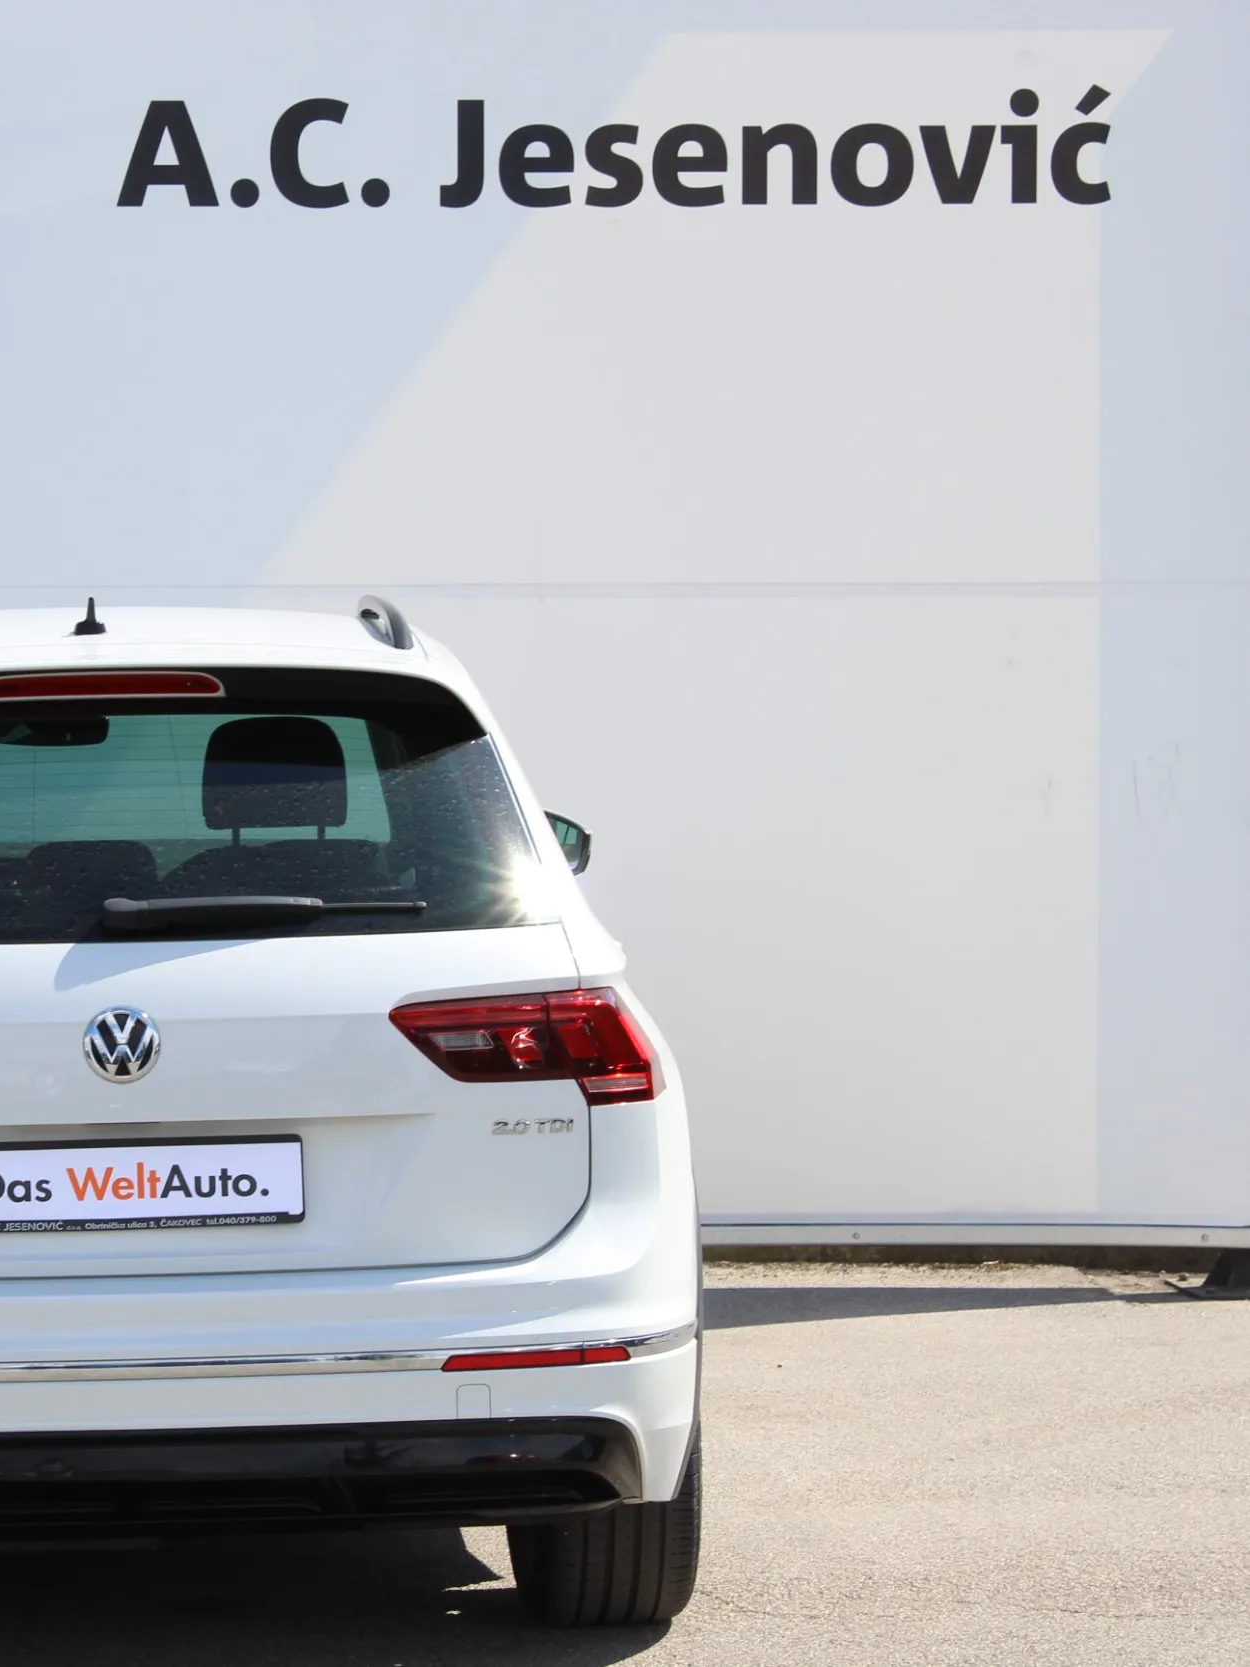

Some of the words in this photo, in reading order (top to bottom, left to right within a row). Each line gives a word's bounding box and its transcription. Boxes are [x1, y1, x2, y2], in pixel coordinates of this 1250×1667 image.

[116, 98, 390, 209] A.C.
[440, 84, 1111, 208] Jesenović
[534, 1118, 575, 1134] TDI
[66, 1162, 269, 1201] WeltAuto.
[3, 1220, 64, 1232] JESENOVIĆ
[160, 1218, 202, 1228] ČAKOVEC
